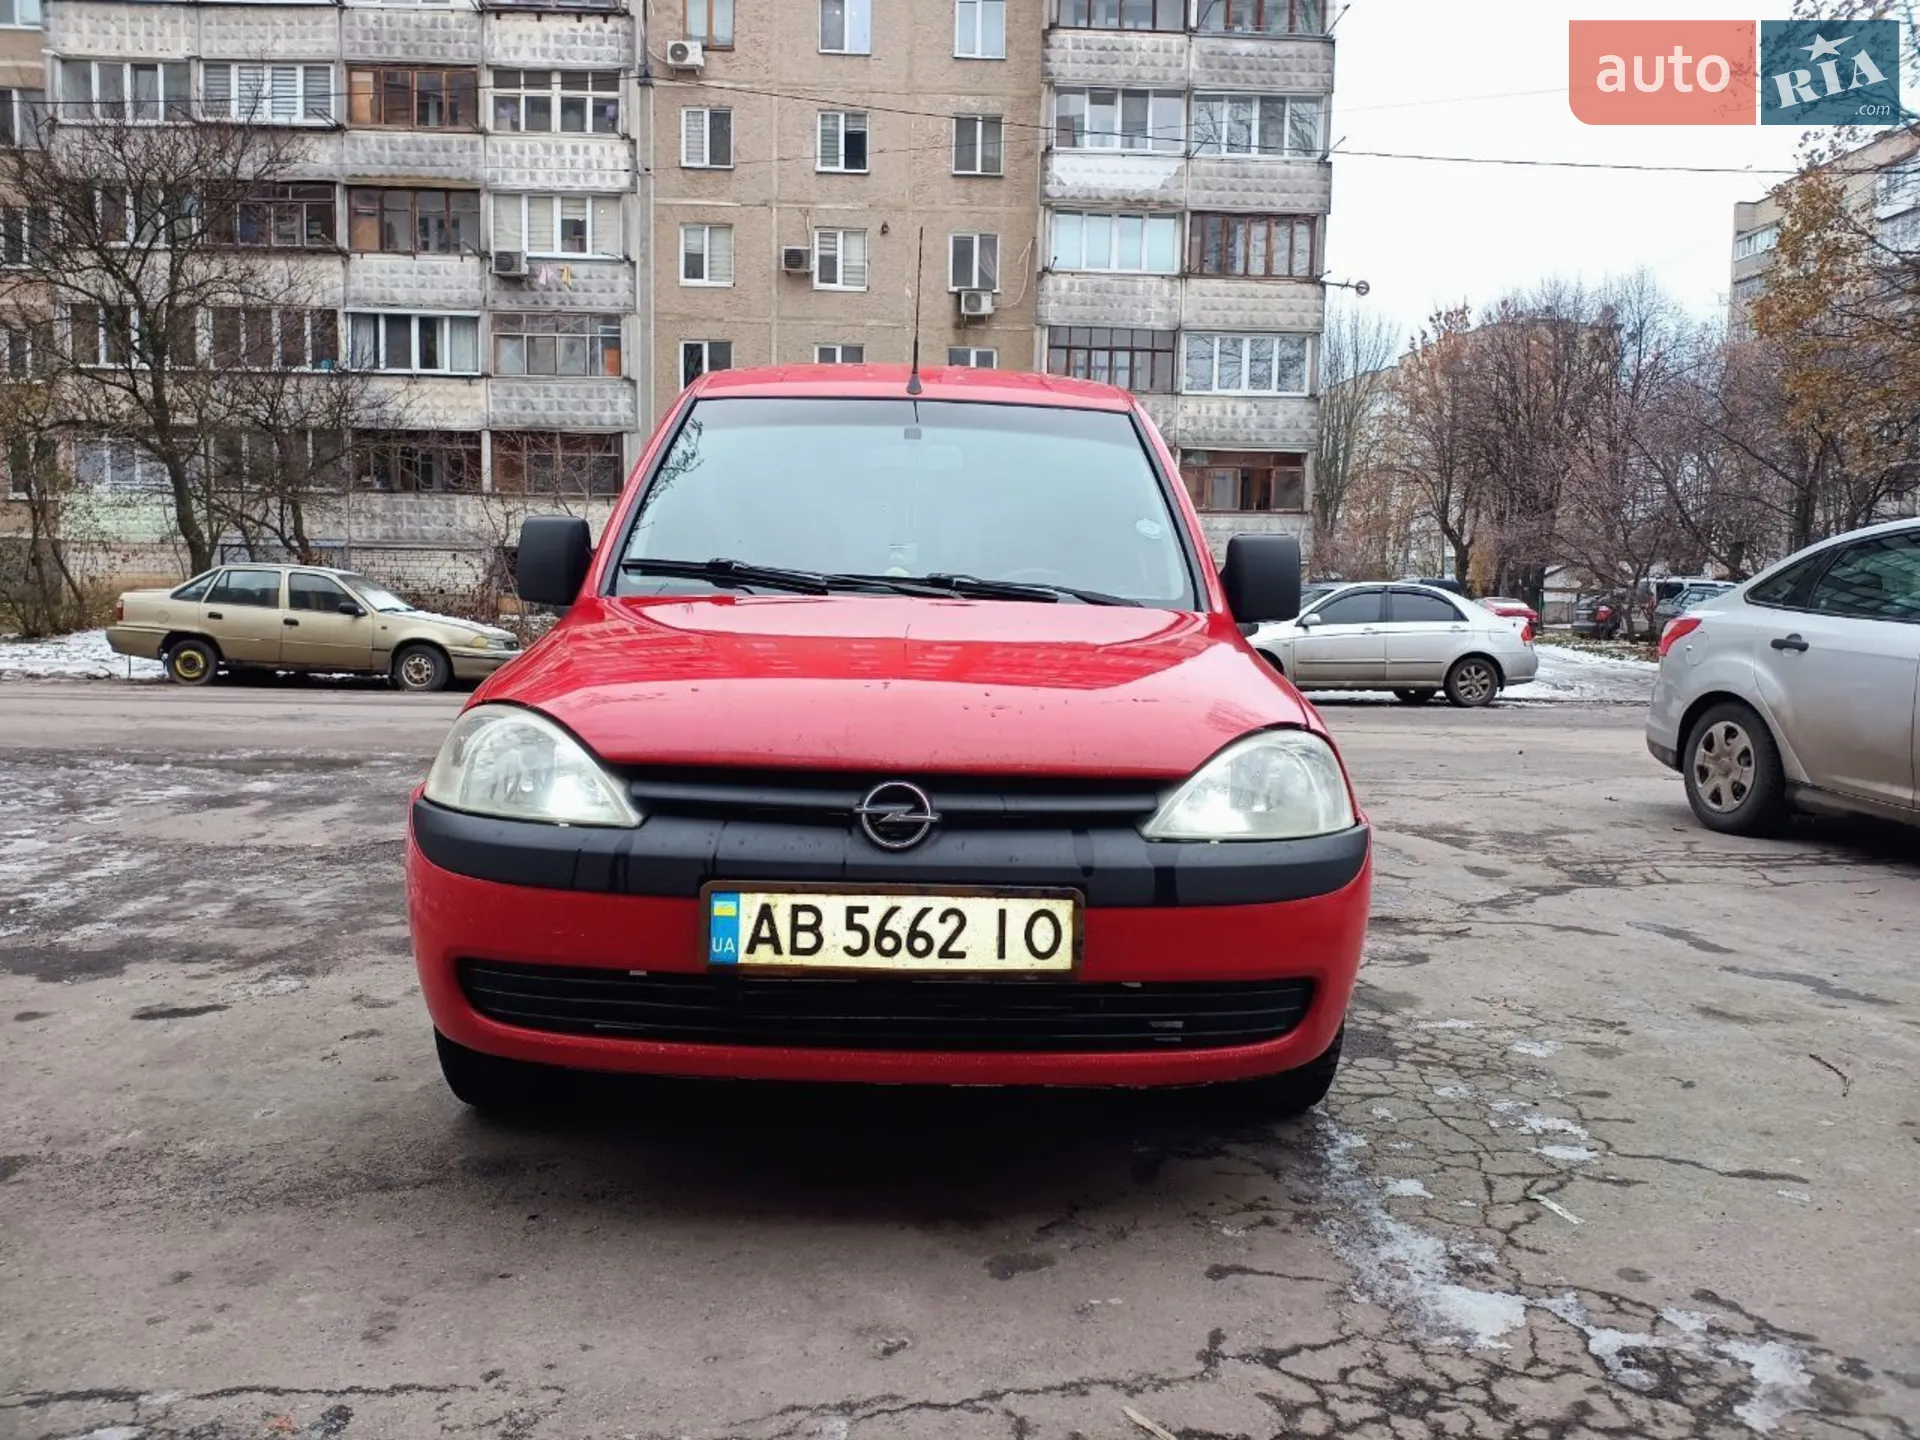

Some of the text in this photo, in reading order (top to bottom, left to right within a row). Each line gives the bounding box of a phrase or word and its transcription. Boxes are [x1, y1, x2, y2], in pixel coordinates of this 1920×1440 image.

[711, 938, 735, 953] UA
[746, 903, 1062, 960] AB 5662 IO
